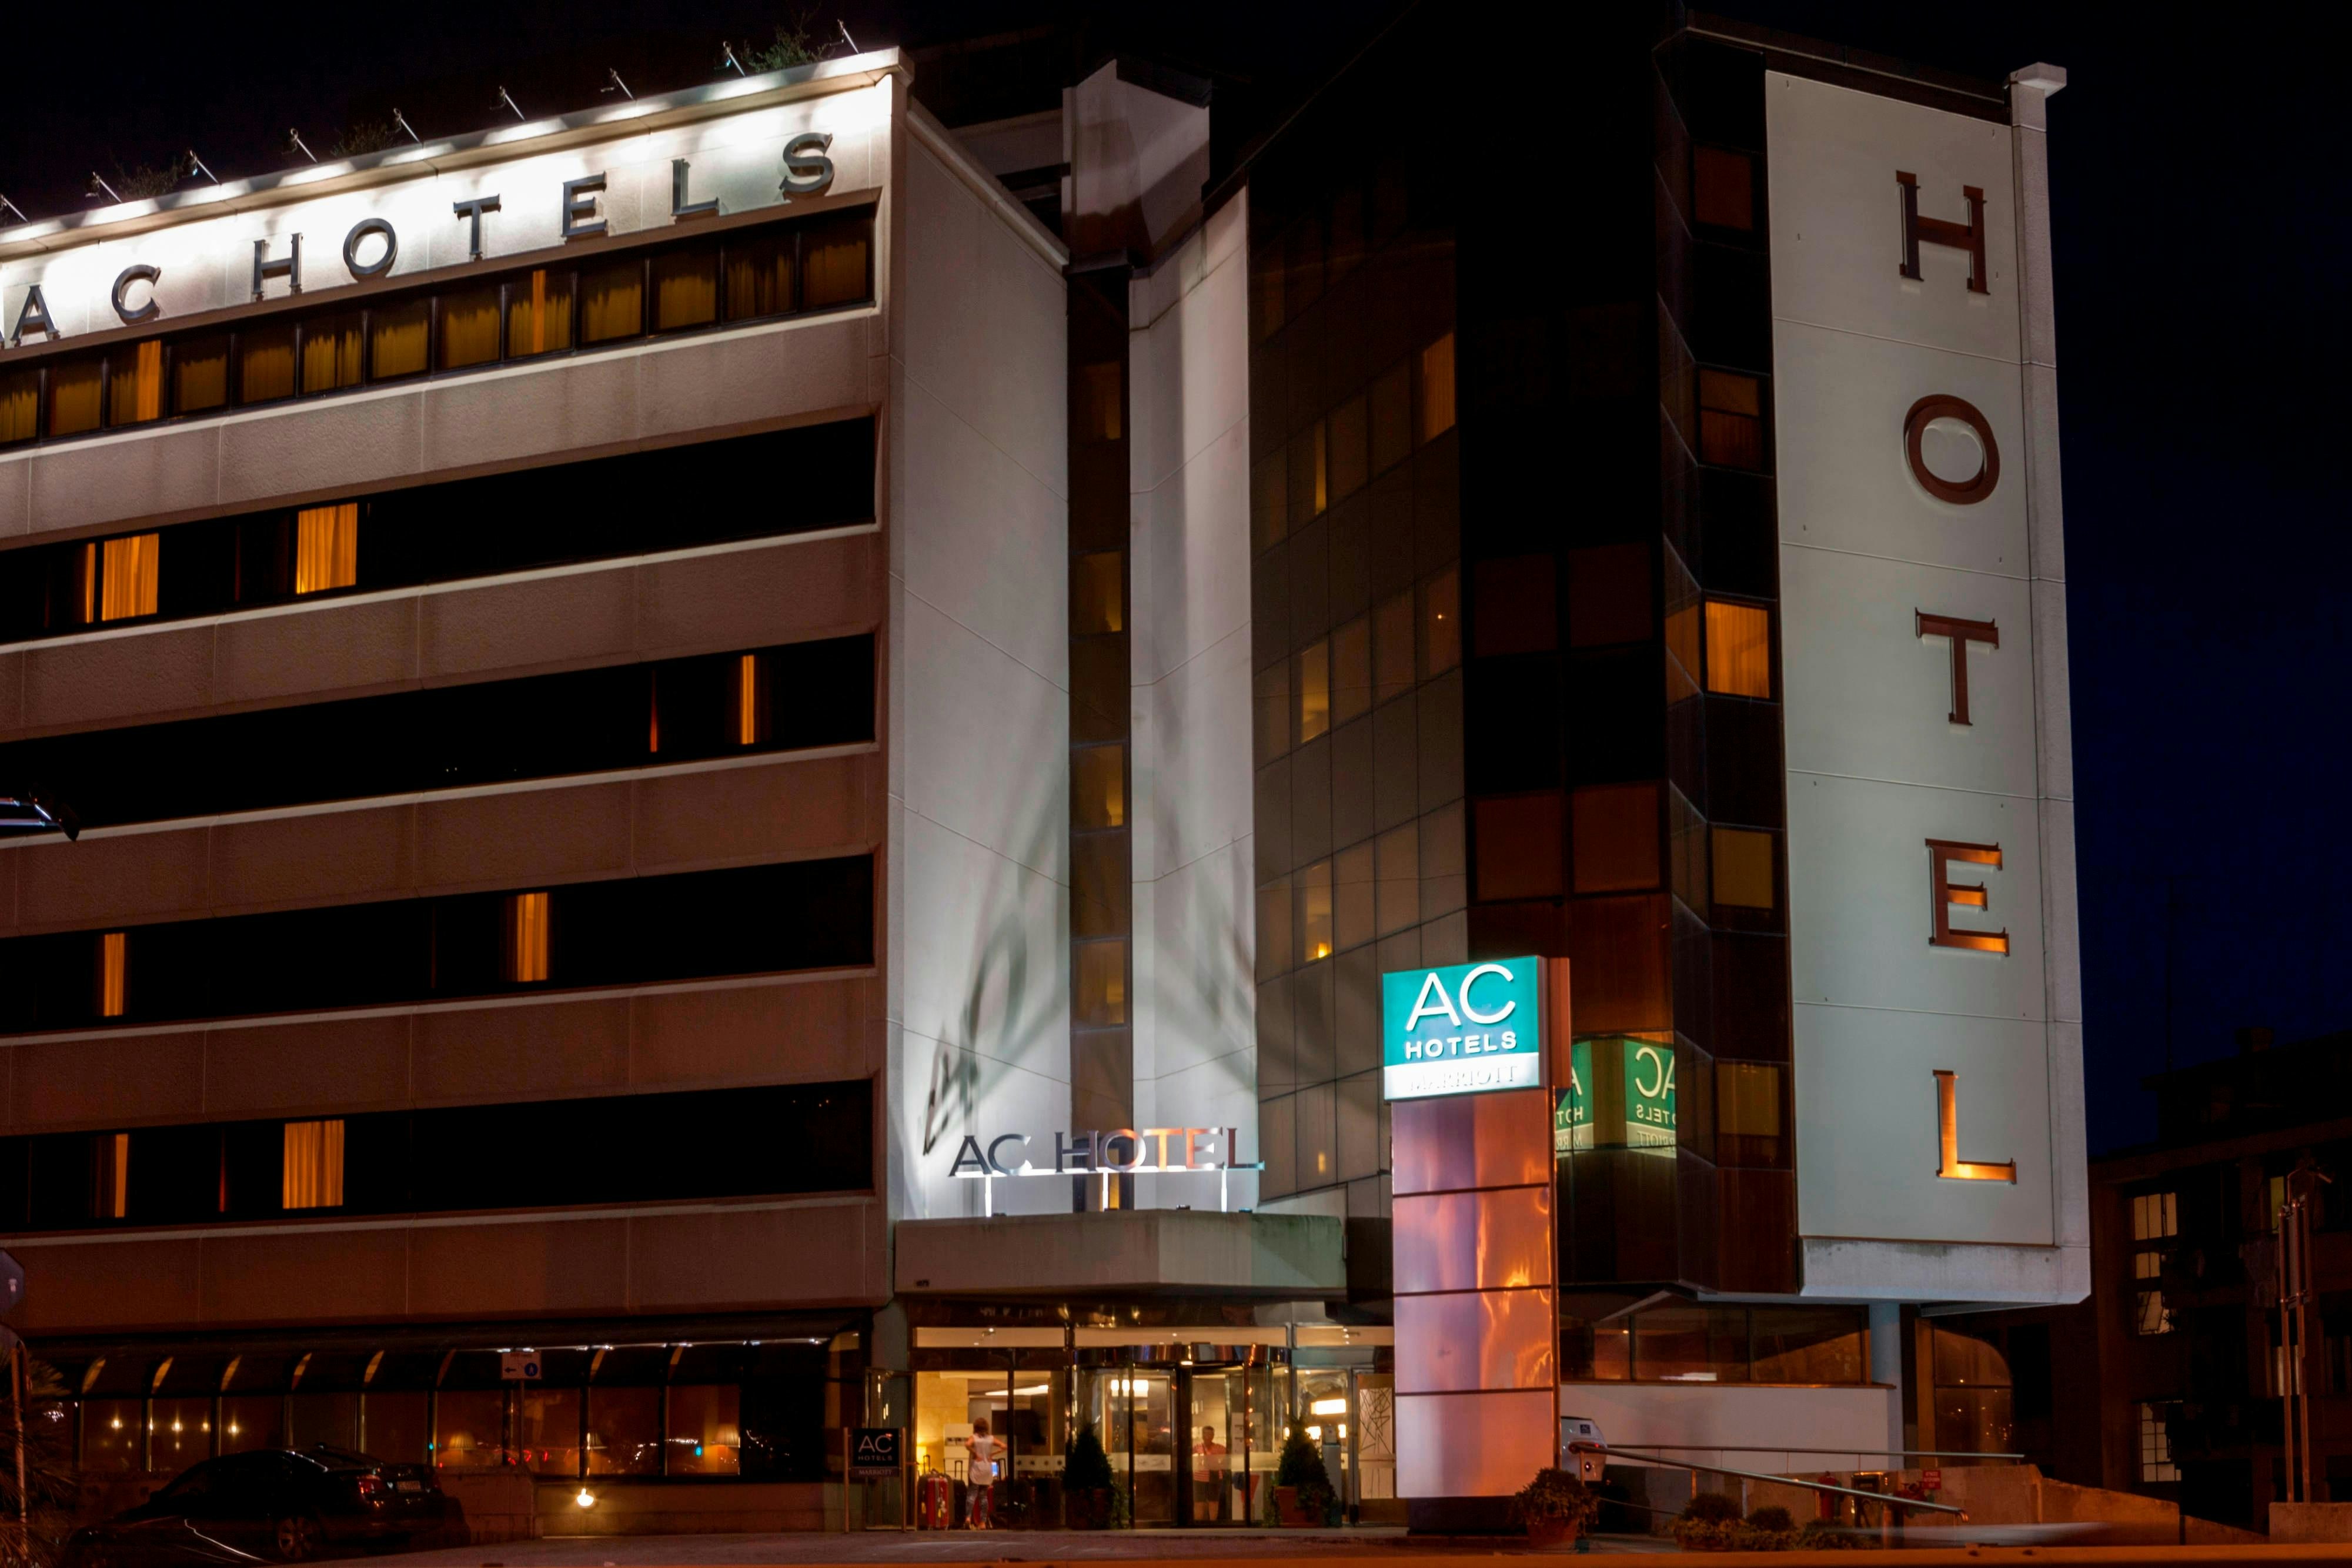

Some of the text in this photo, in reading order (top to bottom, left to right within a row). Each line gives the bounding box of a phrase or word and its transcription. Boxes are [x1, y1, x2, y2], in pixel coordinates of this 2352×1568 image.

[252, 132, 834, 295] HOTELS
[1896, 170, 2017, 1183] HOTEL
[1405, 964, 1516, 1031] AC
[1405, 1031, 1518, 1060] HOTELS
[948, 1126, 1265, 1176] AC HOTEL
[858, 1435, 892, 1453] AC
